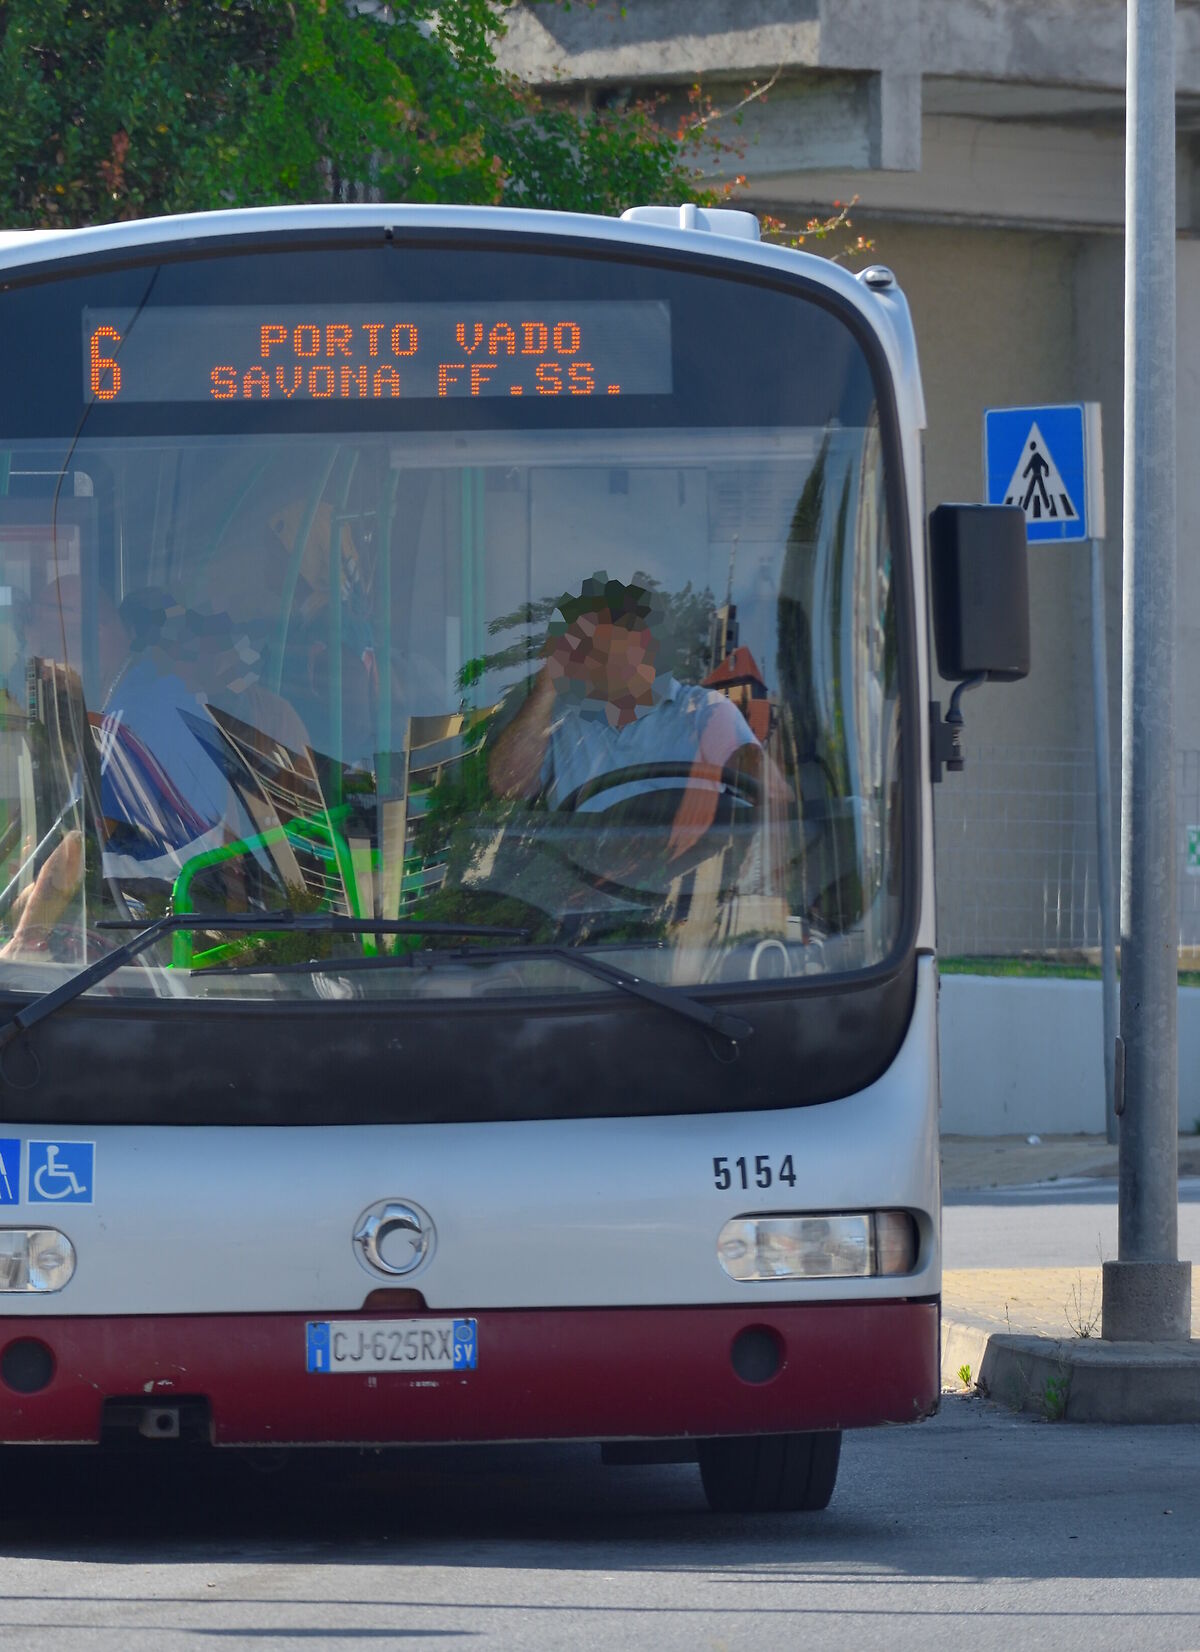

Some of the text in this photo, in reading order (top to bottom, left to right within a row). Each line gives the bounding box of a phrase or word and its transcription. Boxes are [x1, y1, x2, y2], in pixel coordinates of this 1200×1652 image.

[260, 322, 581, 357] PORTO VADO
[90, 326, 121, 400] 6
[210, 362, 621, 398] SAVONA FF.SS.
[712, 1154, 797, 1191] 5154
[454, 1343, 474, 1363] SV
